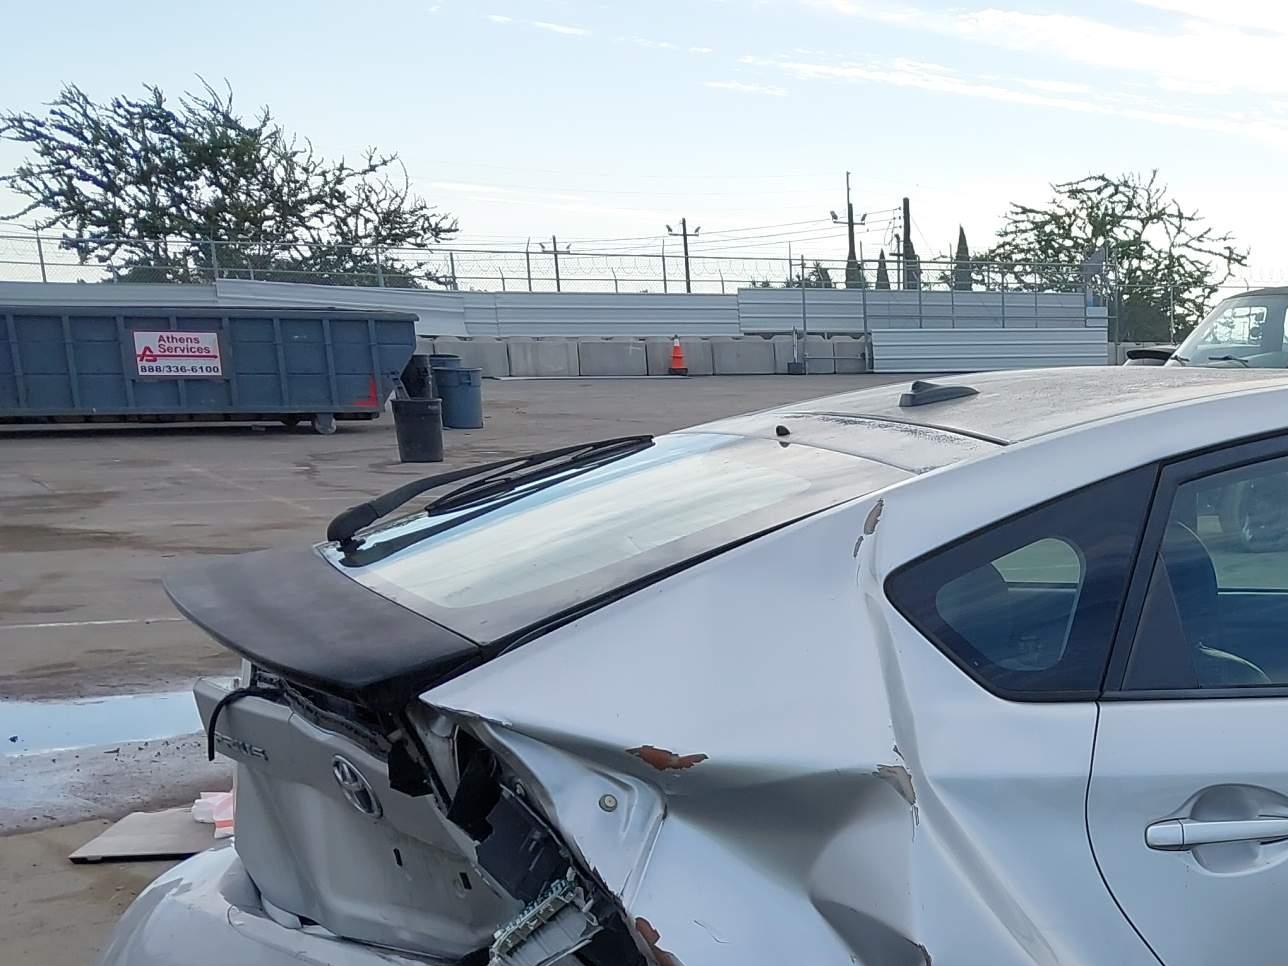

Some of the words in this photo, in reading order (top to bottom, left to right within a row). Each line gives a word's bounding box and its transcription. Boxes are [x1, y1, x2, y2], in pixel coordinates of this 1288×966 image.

[158, 334, 200, 344] Athens
[158, 344, 211, 354] Services
[140, 365, 219, 373] 888/336-6100
